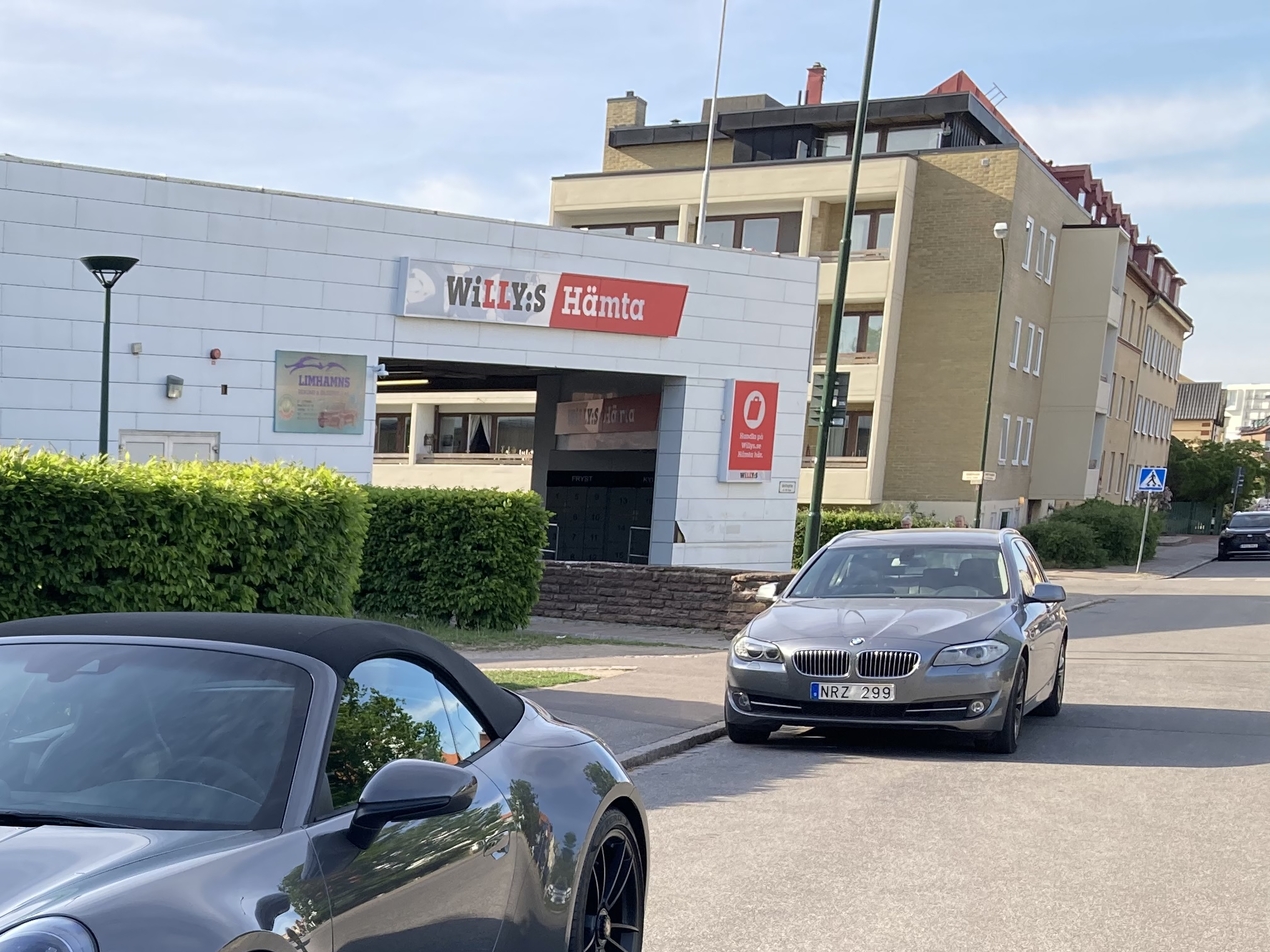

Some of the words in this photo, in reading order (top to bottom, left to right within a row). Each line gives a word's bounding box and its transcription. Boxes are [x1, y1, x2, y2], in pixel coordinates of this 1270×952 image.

[561, 285, 645, 321] Hämta
[298, 375, 350, 388] LIMHAMNS
[821, 685, 849, 699] NRZ
[861, 686, 891, 699] 299
